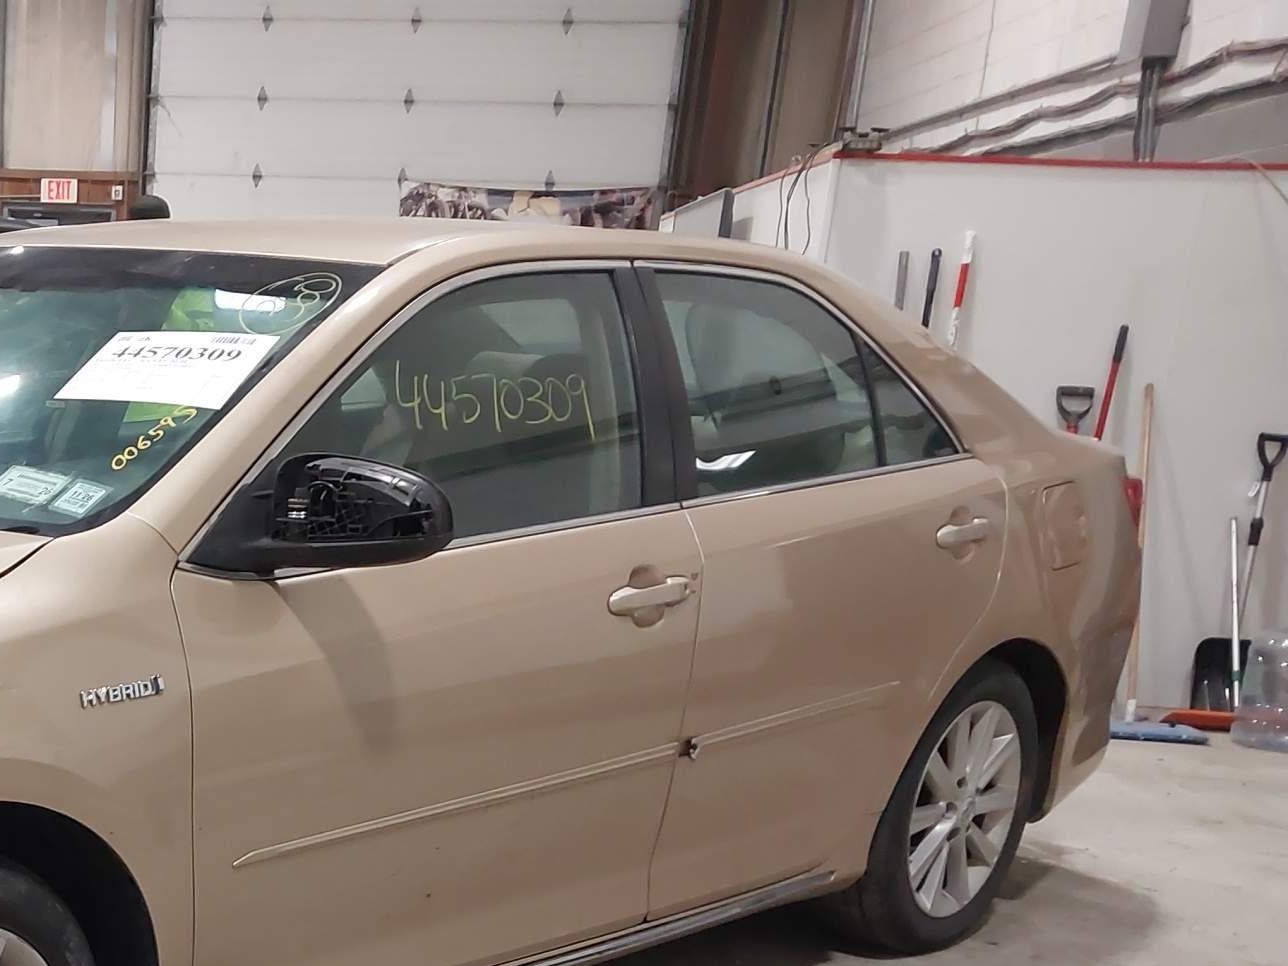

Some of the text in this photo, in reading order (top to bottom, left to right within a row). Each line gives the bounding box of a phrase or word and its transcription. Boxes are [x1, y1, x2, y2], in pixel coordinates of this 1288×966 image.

[47, 180, 72, 200] EXIT
[111, 346, 243, 361] 44570309
[394, 359, 596, 442] 44570309
[111, 405, 198, 471] 006595
[80, 680, 153, 709] HYBRID
